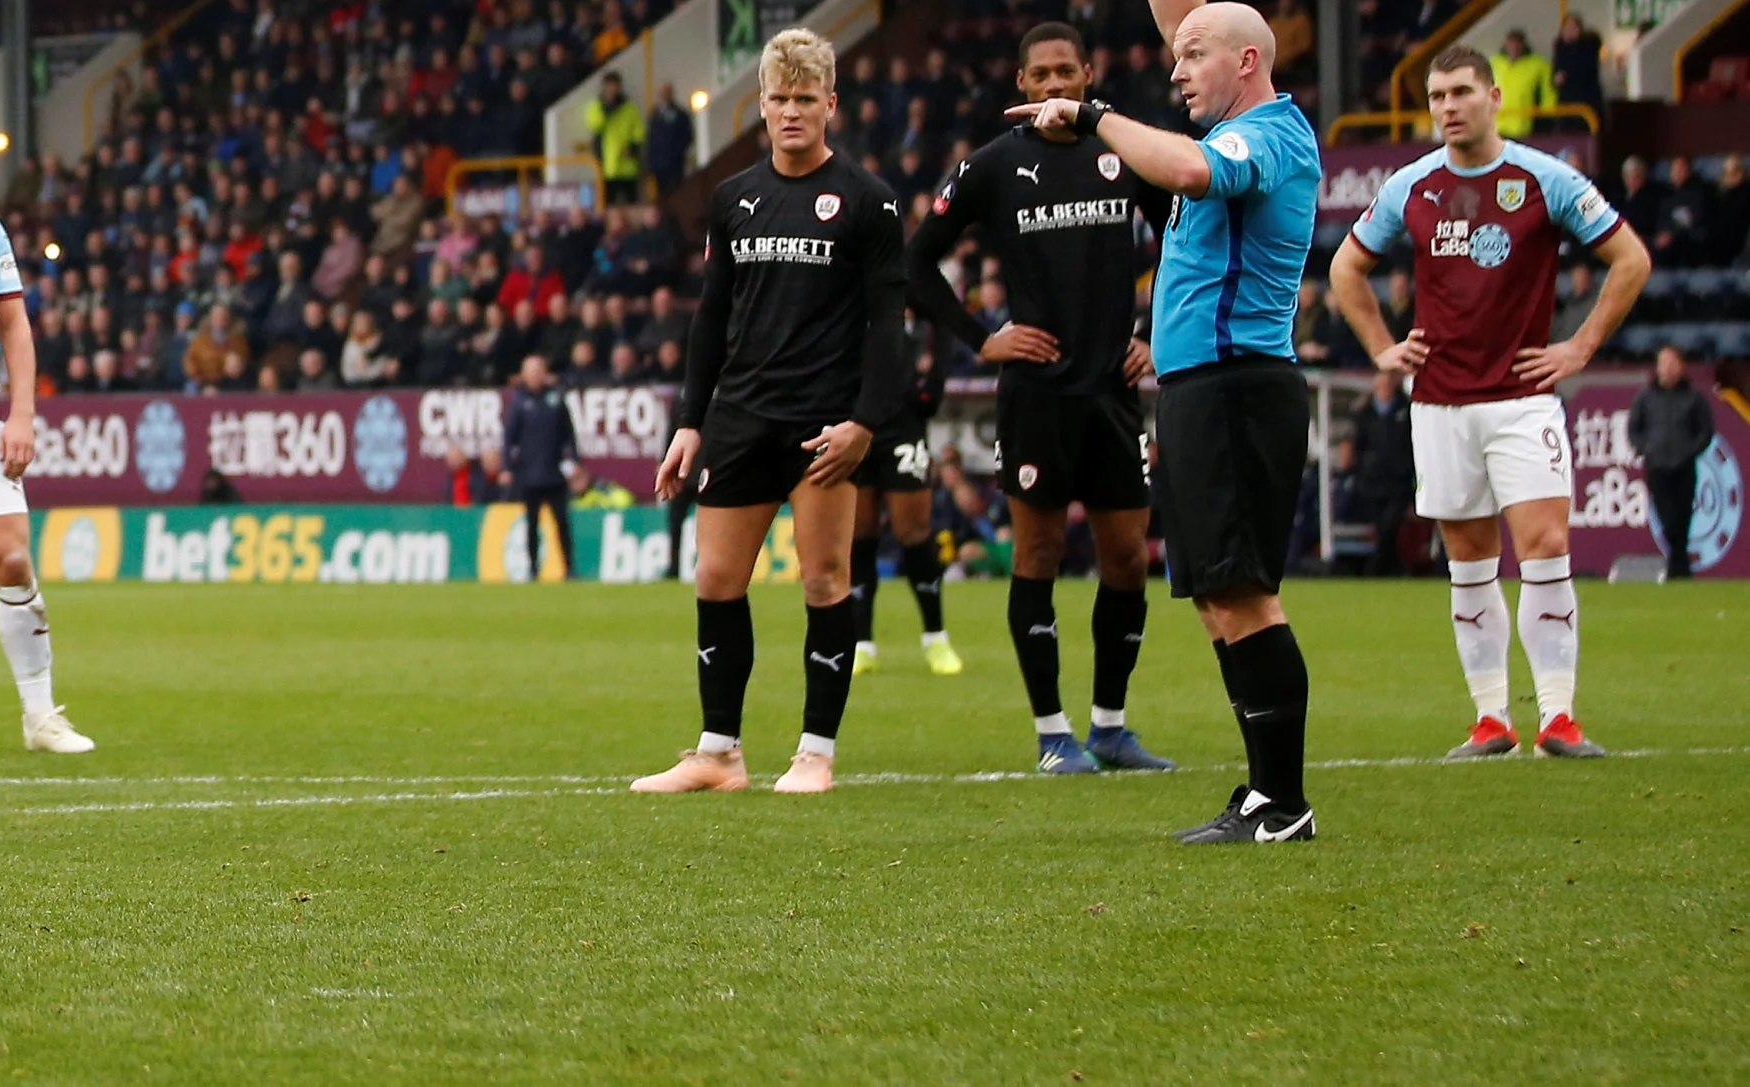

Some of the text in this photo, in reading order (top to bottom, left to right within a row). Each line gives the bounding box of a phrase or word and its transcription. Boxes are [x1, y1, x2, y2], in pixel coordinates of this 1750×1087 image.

[1430, 238, 1470, 257] LaBa
[1541, 427, 1563, 464] 9
[1568, 465, 1650, 529] LaBa
[143, 514, 448, 585] bet365.com
